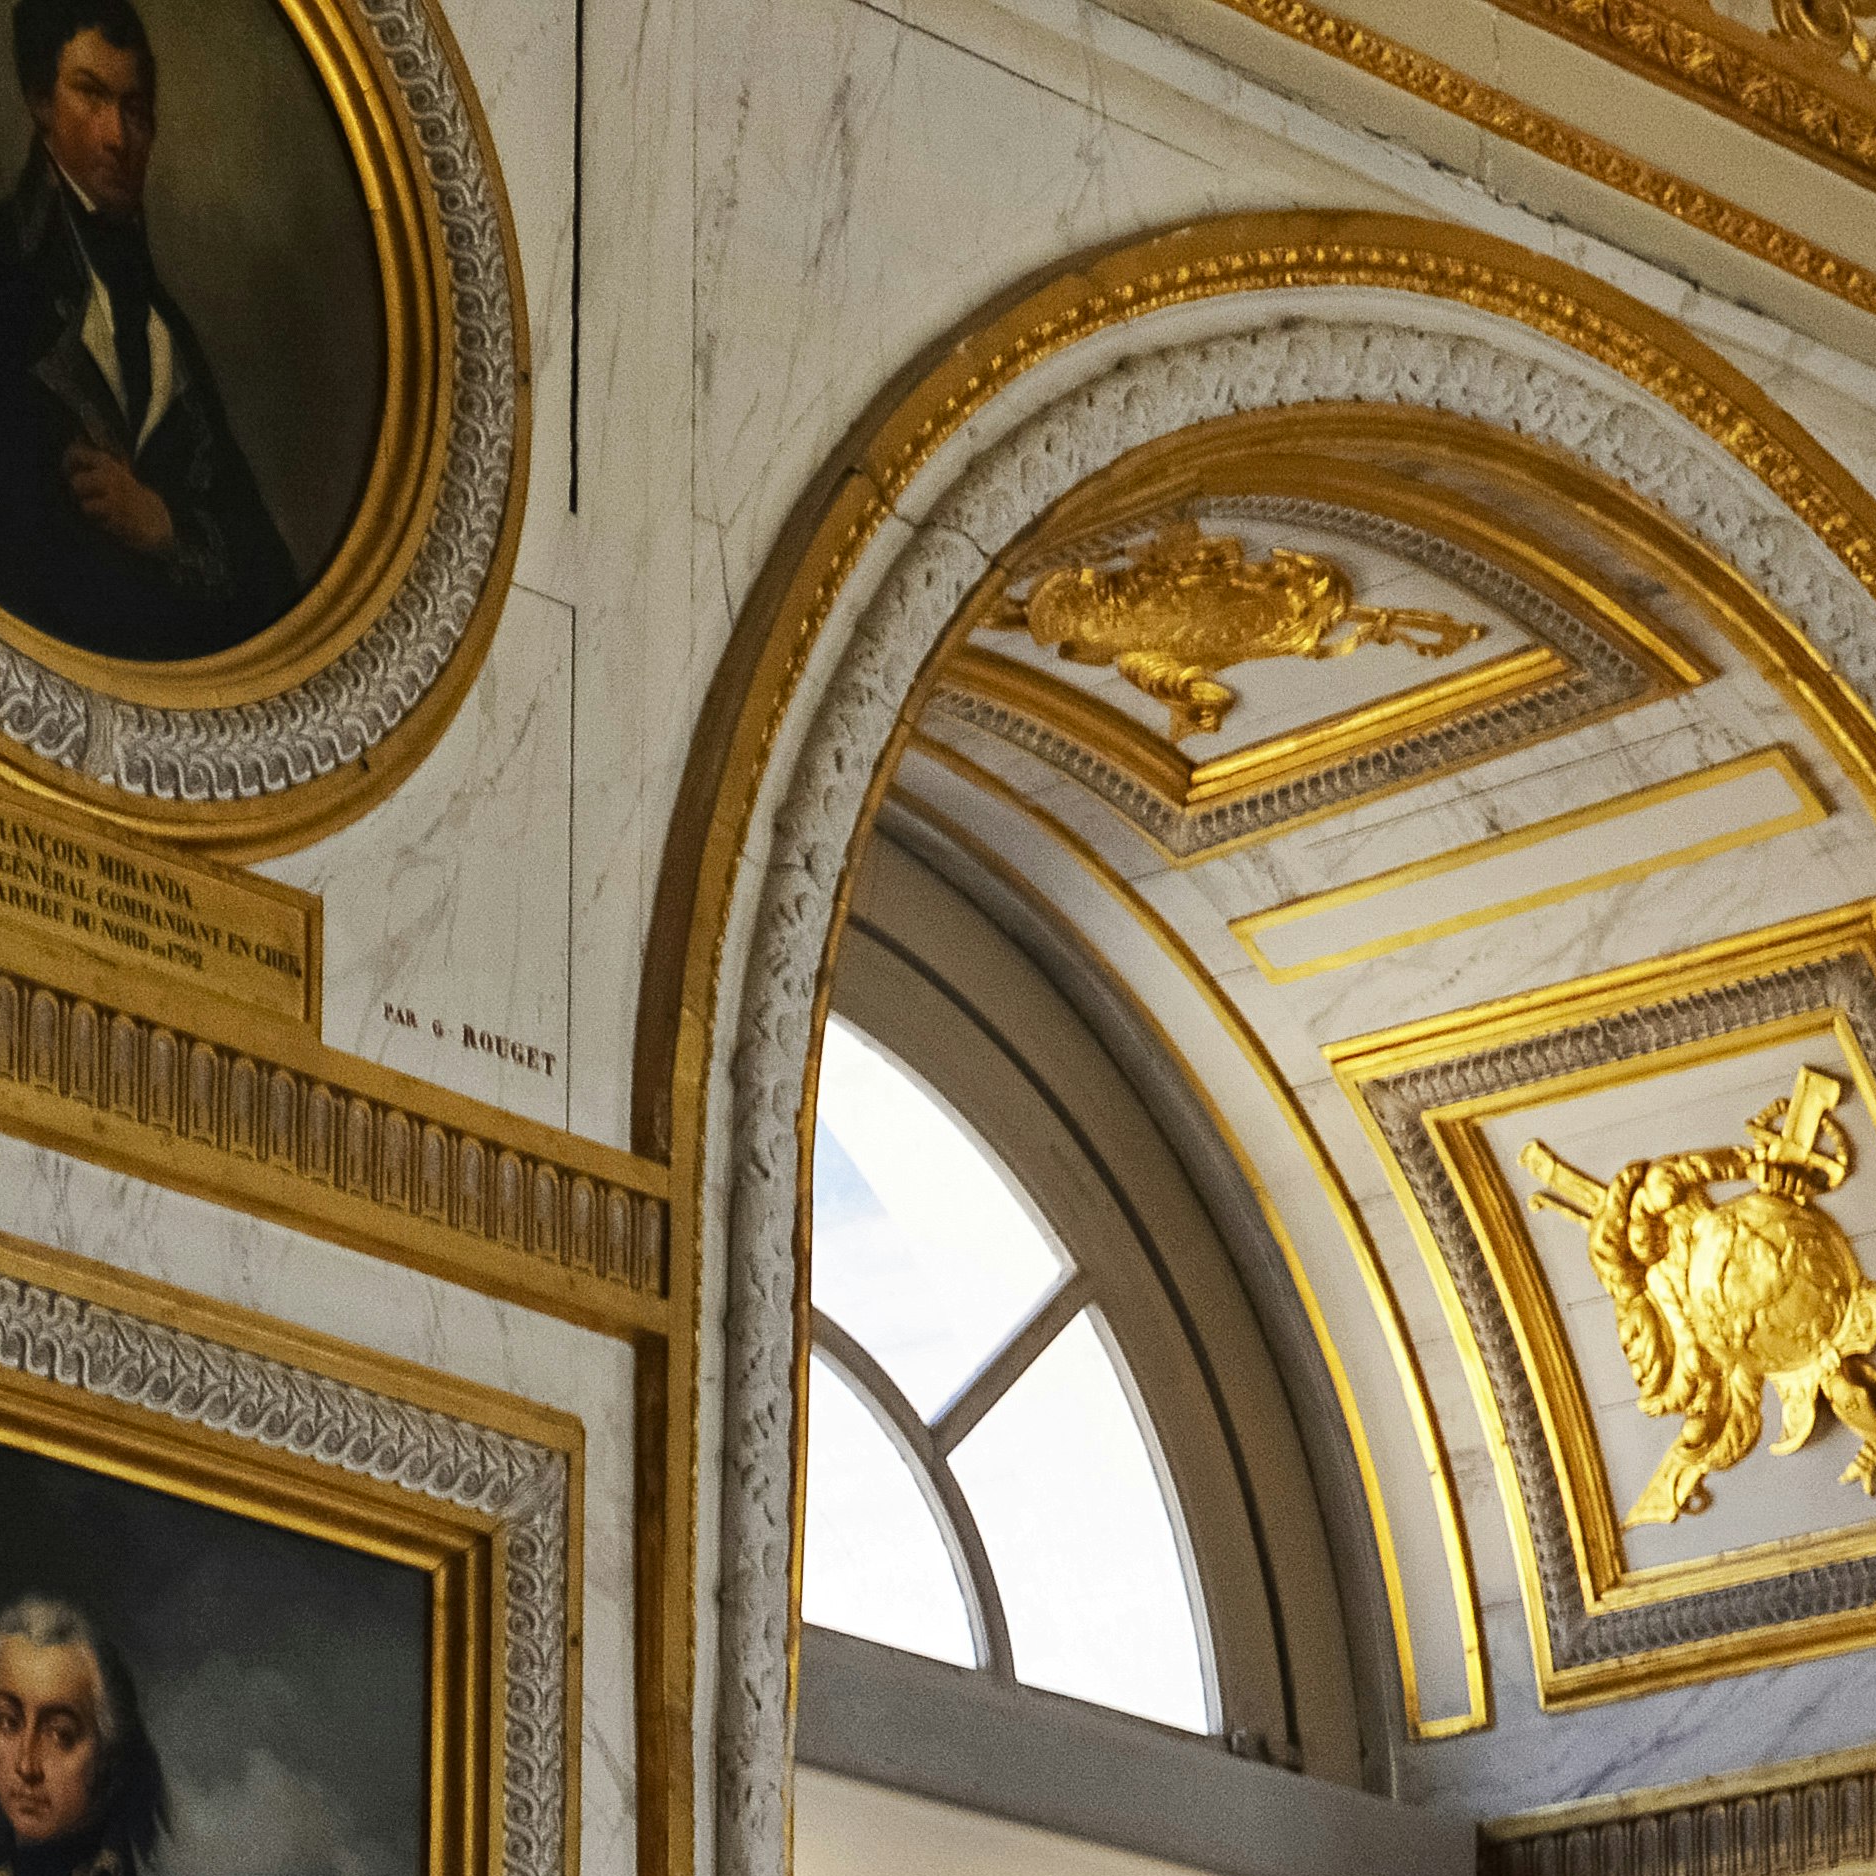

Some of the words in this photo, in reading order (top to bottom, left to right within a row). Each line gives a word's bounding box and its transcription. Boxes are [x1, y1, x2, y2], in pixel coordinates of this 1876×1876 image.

[73, 908, 96, 931] DU
[103, 918, 149, 951] NORD
[97, 887, 222, 948] COMMANDANT
[227, 932, 251, 957] EN
[383, 1002, 418, 1029] PAR
[463, 1023, 557, 1077] ROUGET
